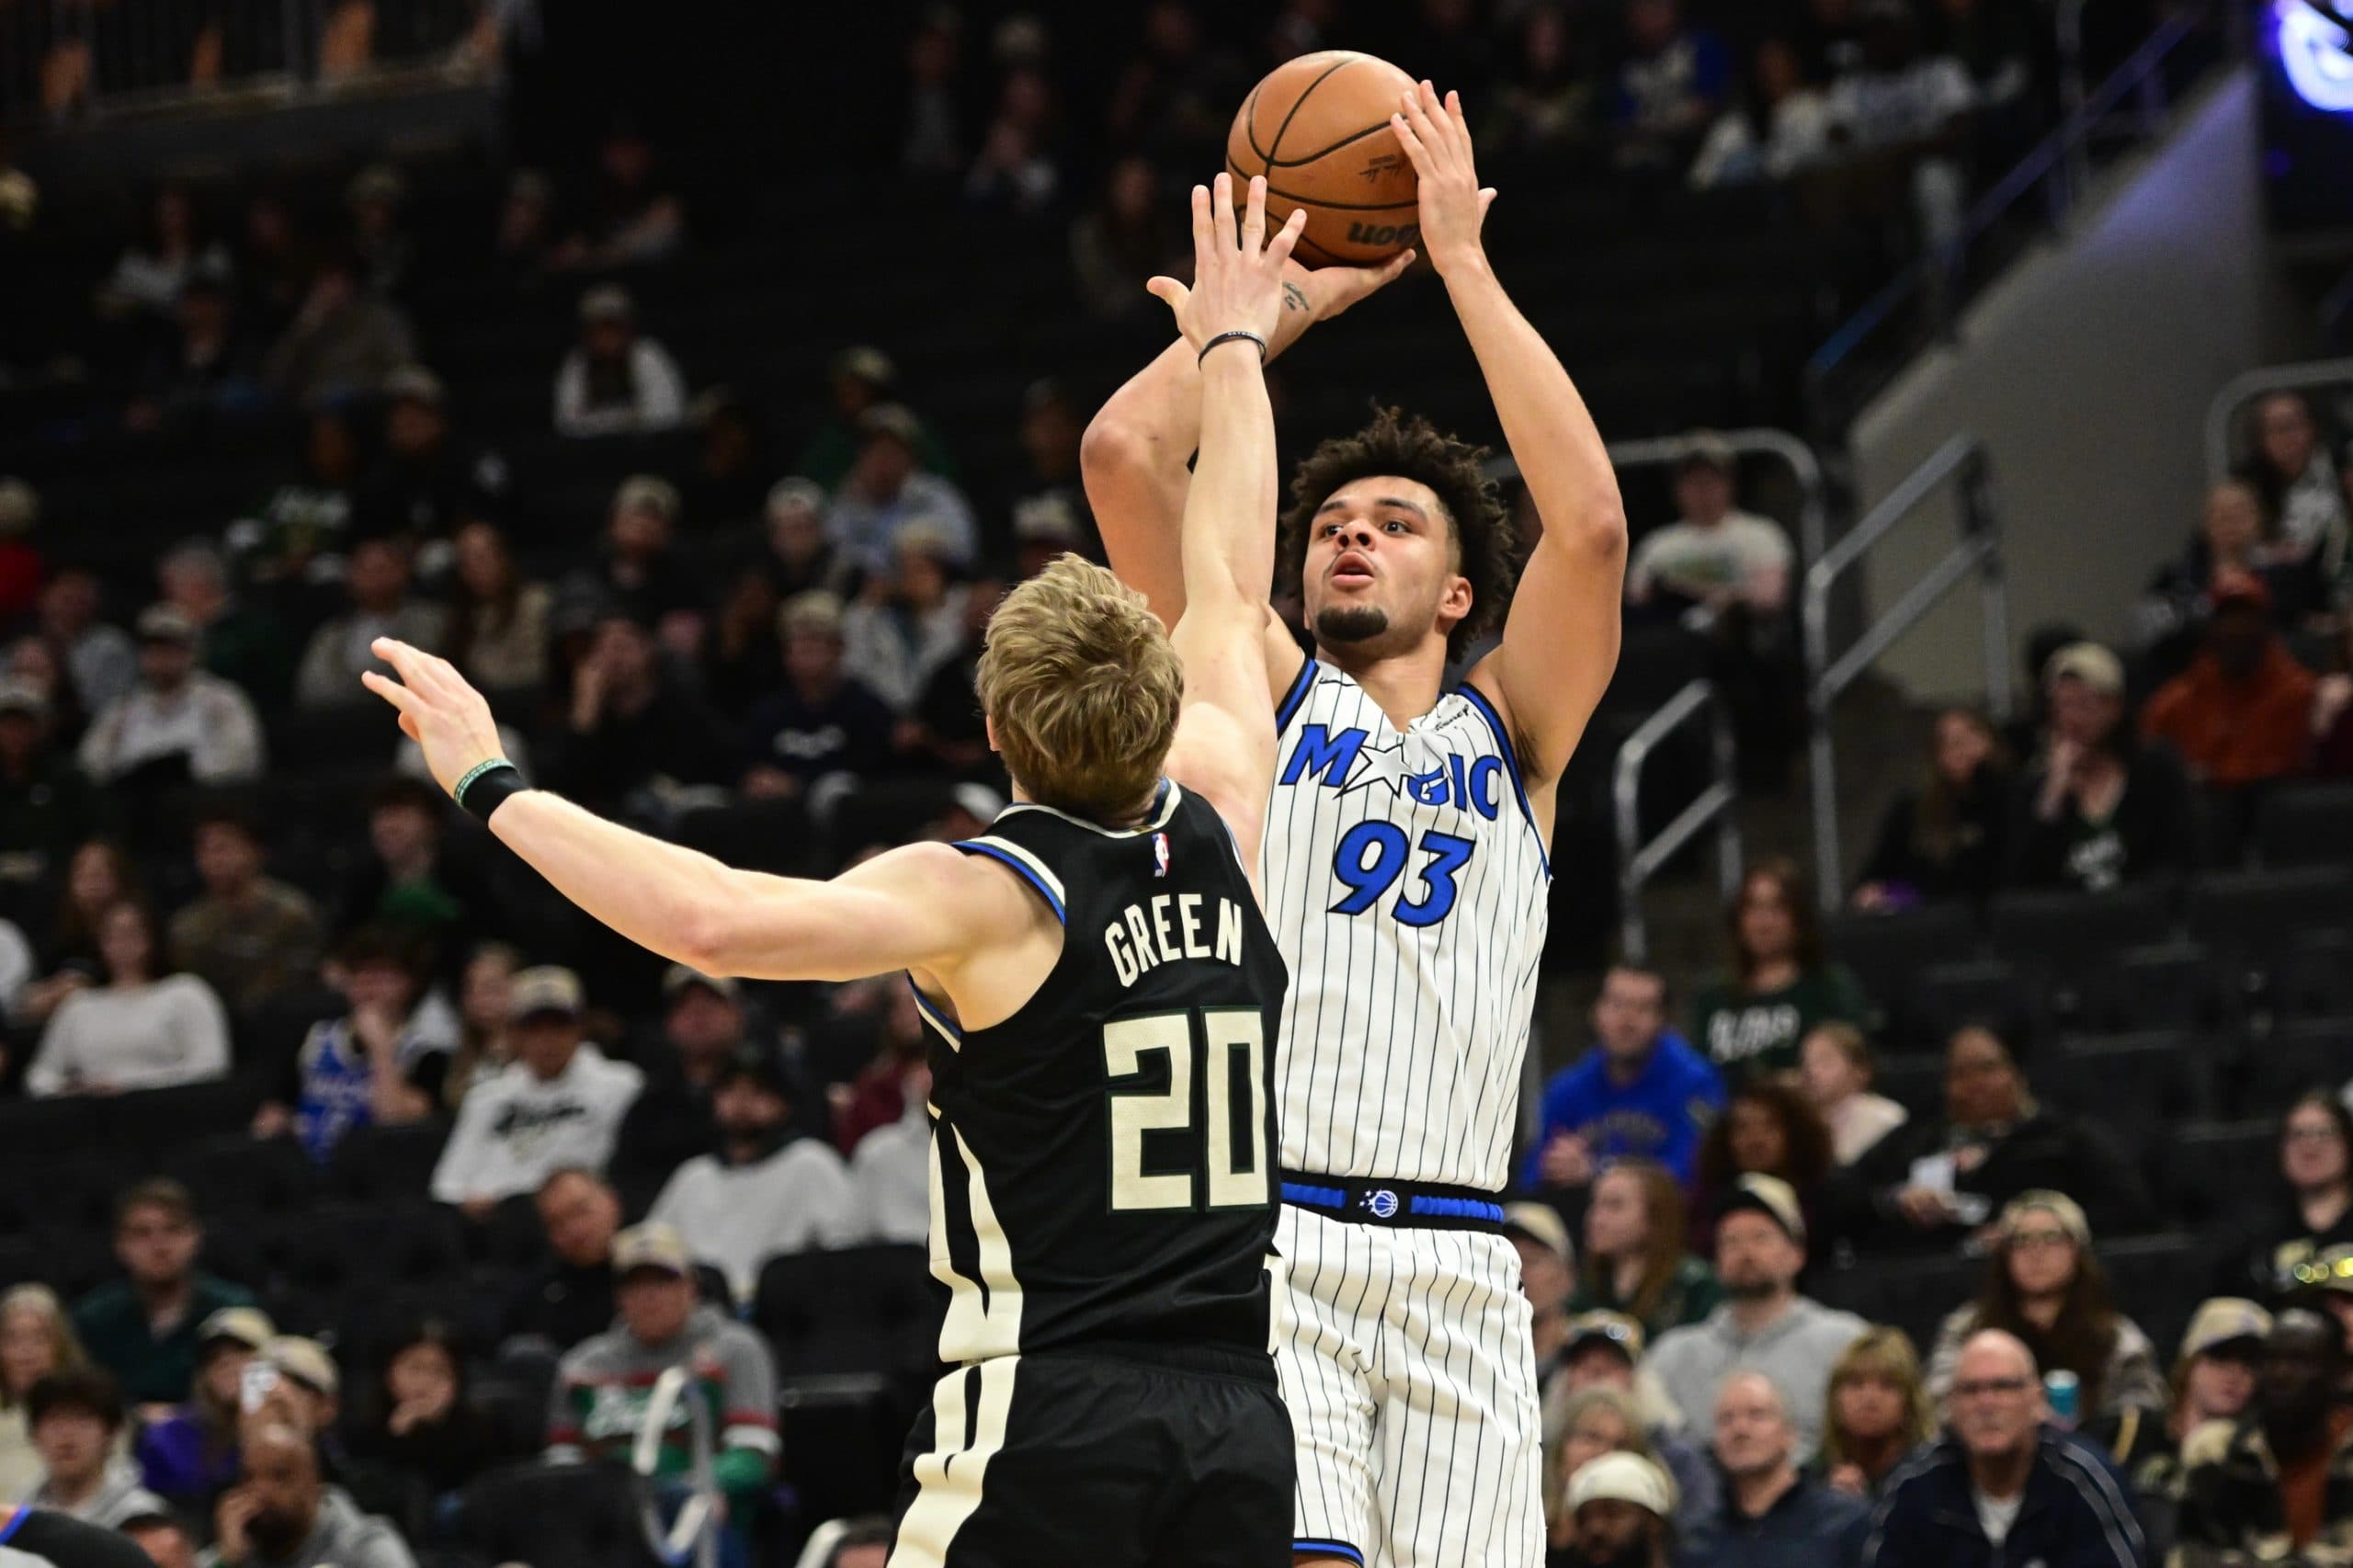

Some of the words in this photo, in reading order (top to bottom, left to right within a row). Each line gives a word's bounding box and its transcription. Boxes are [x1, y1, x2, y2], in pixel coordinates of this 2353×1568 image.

[1327, 820, 1476, 928] 93
[1105, 893, 1243, 988] GREEN
[1102, 1006, 1271, 1213] 20
